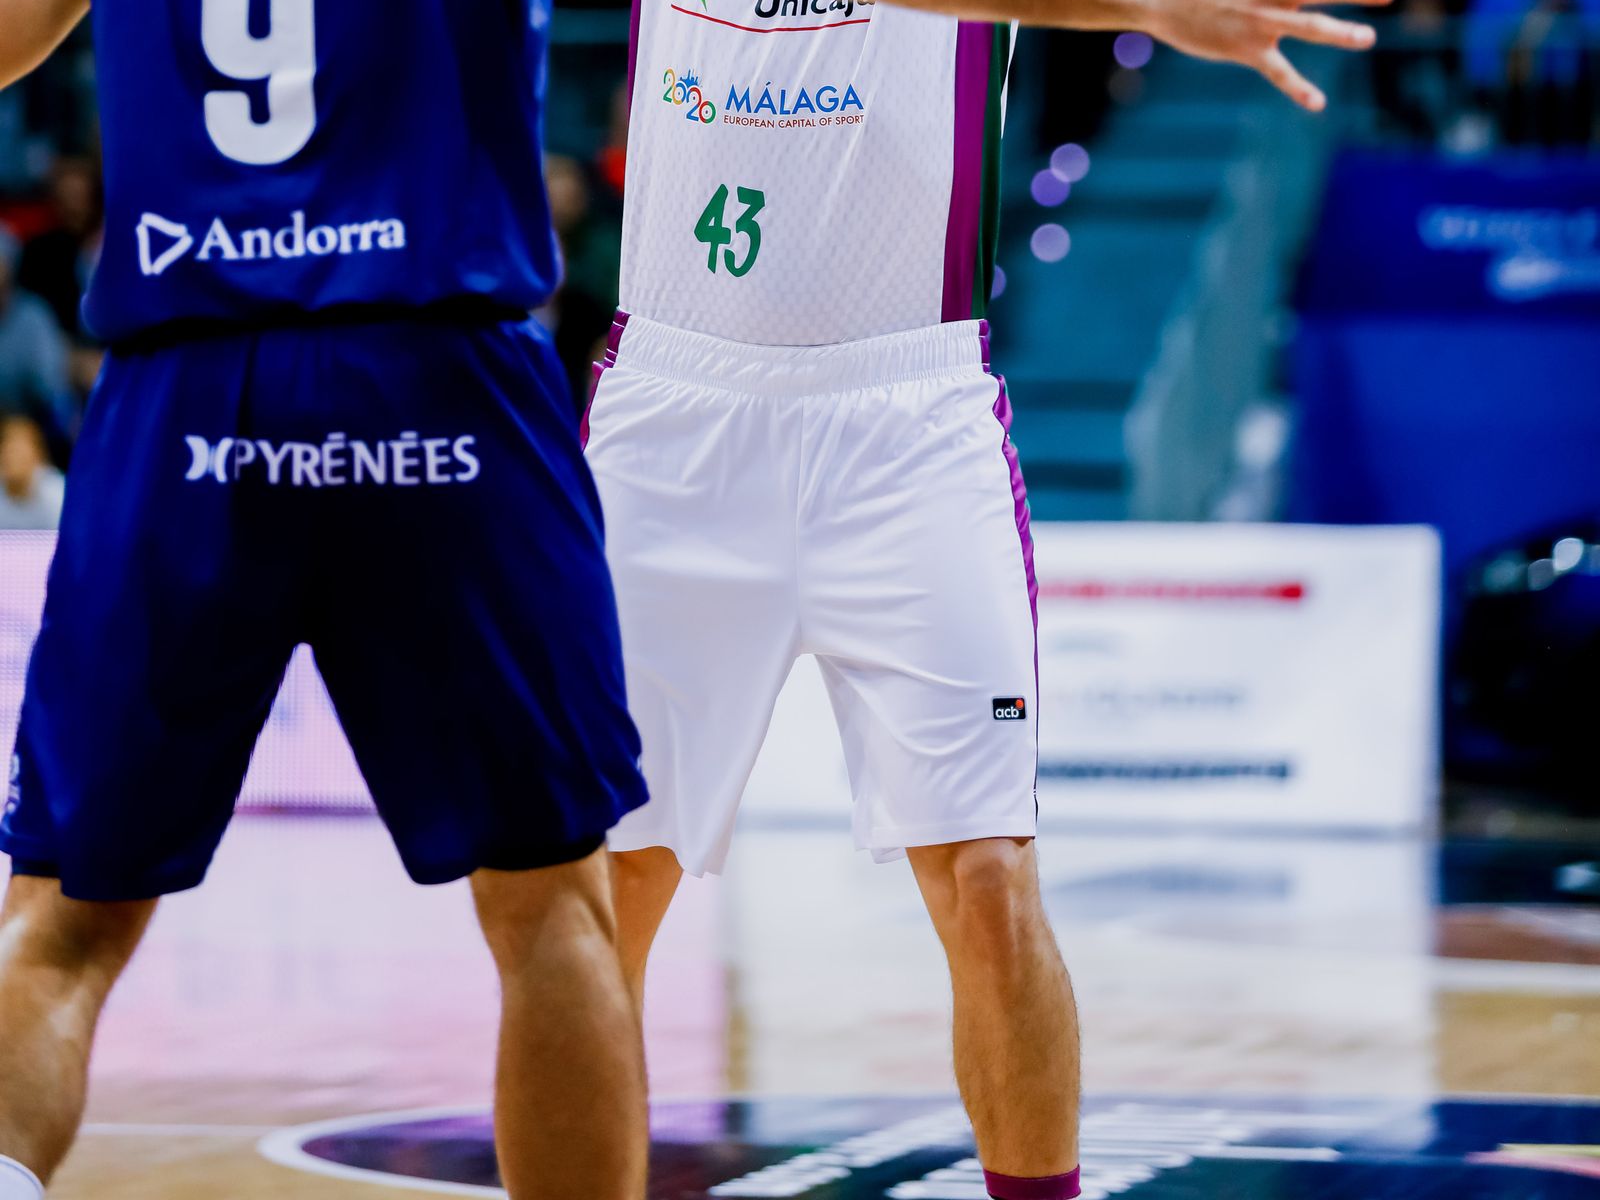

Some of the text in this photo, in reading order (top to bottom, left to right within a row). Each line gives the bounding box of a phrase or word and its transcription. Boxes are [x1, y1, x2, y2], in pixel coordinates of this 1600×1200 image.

[725, 82, 864, 115] MÁLAGA
[723, 114, 865, 128] EUROPEAN CAPITAL OF SPORT
[195, 210, 406, 260] Andorra
[694, 184, 765, 277] 43
[995, 706, 1019, 718] acb
